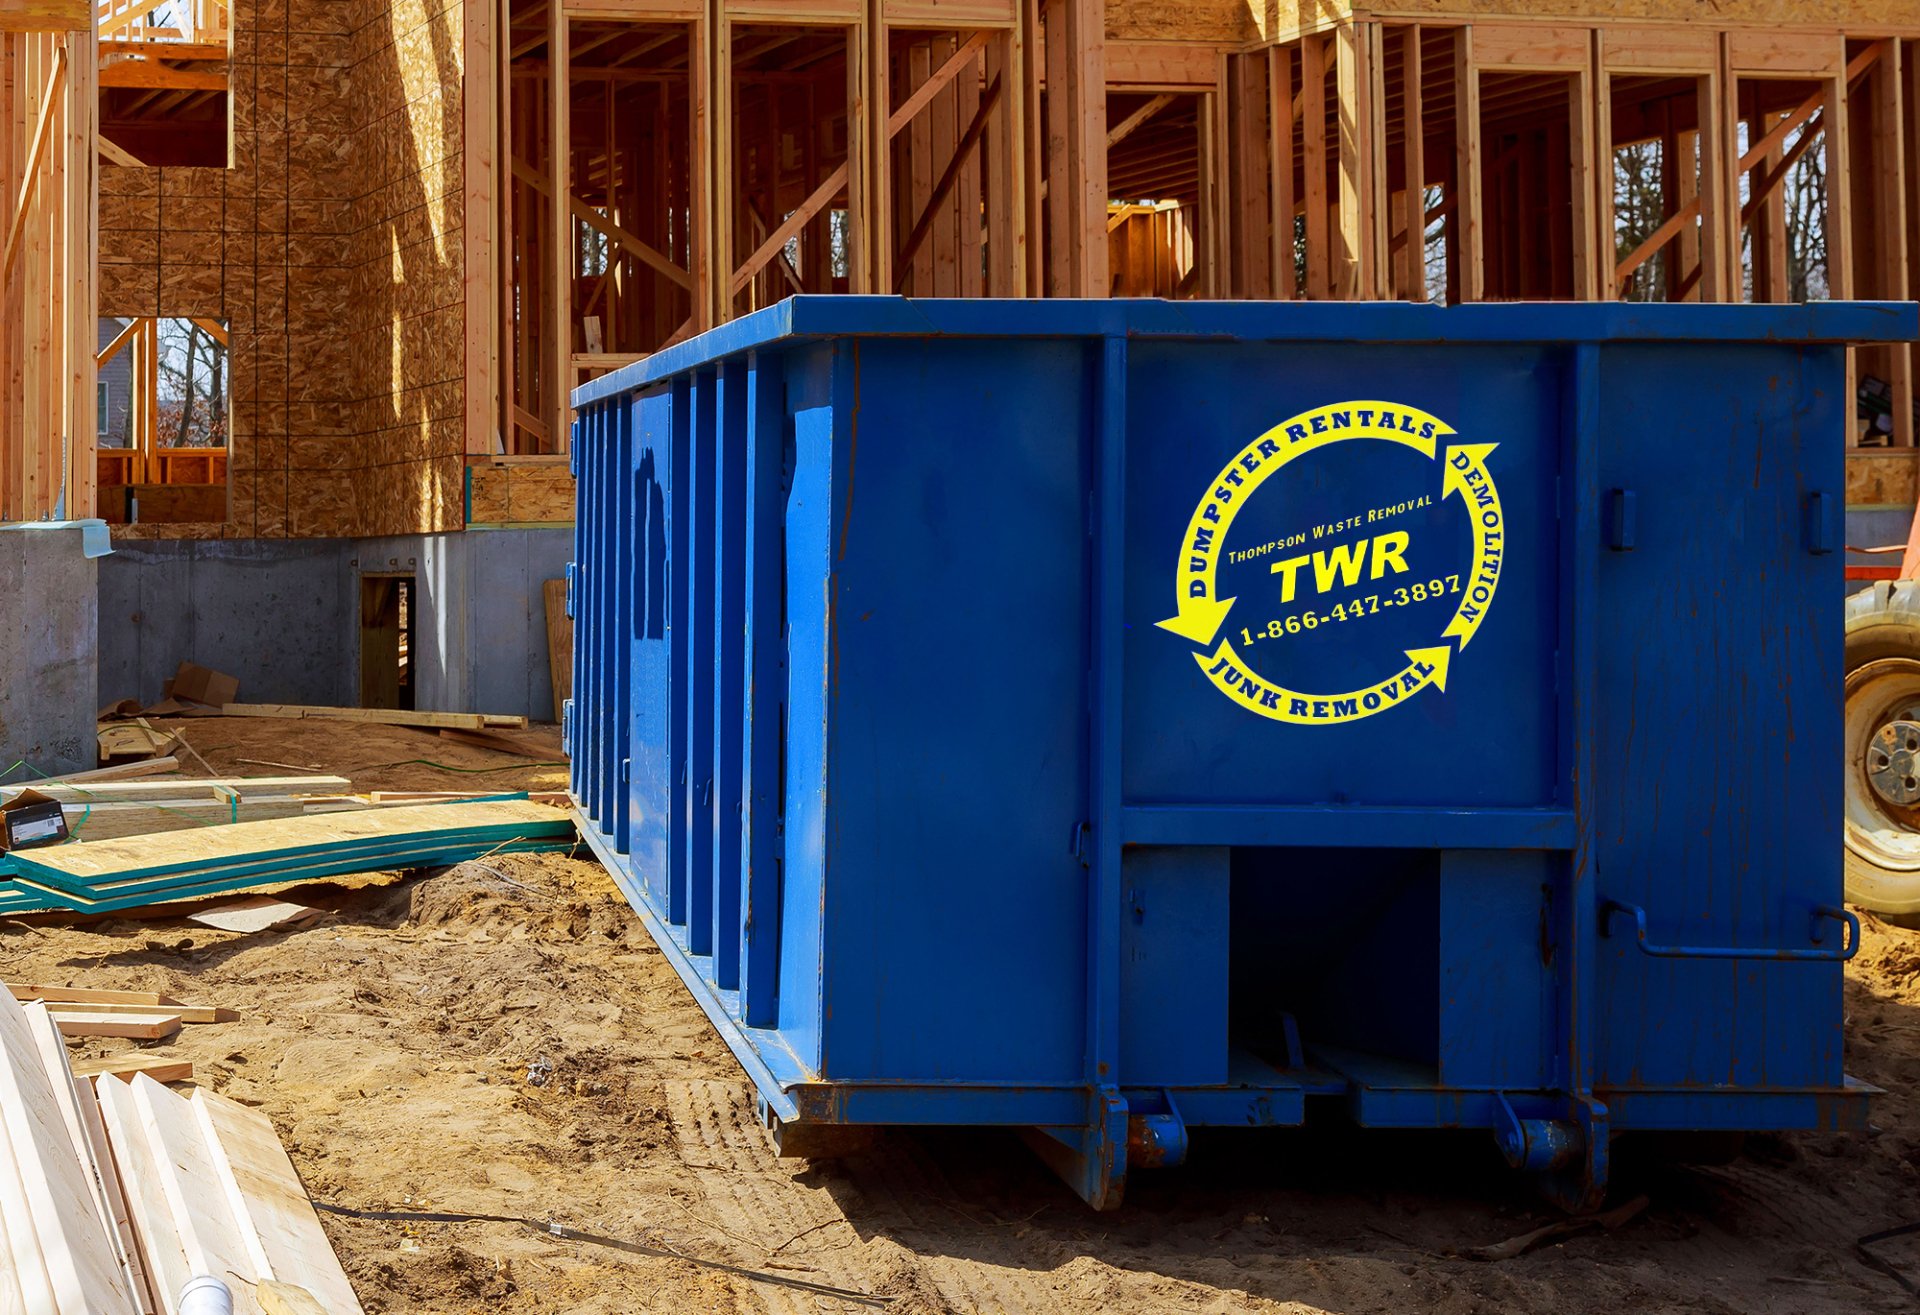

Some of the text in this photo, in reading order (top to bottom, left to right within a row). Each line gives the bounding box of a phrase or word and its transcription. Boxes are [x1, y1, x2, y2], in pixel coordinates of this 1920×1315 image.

[1189, 410, 1437, 599] DUMPSTER RENTALS
[1450, 451, 1501, 623] DEMOLITION
[1270, 530, 1410, 604] TWR
[1240, 574, 1461, 647] 1-866-447-3897
[1208, 657, 1436, 718] JUNK REMOVAL
